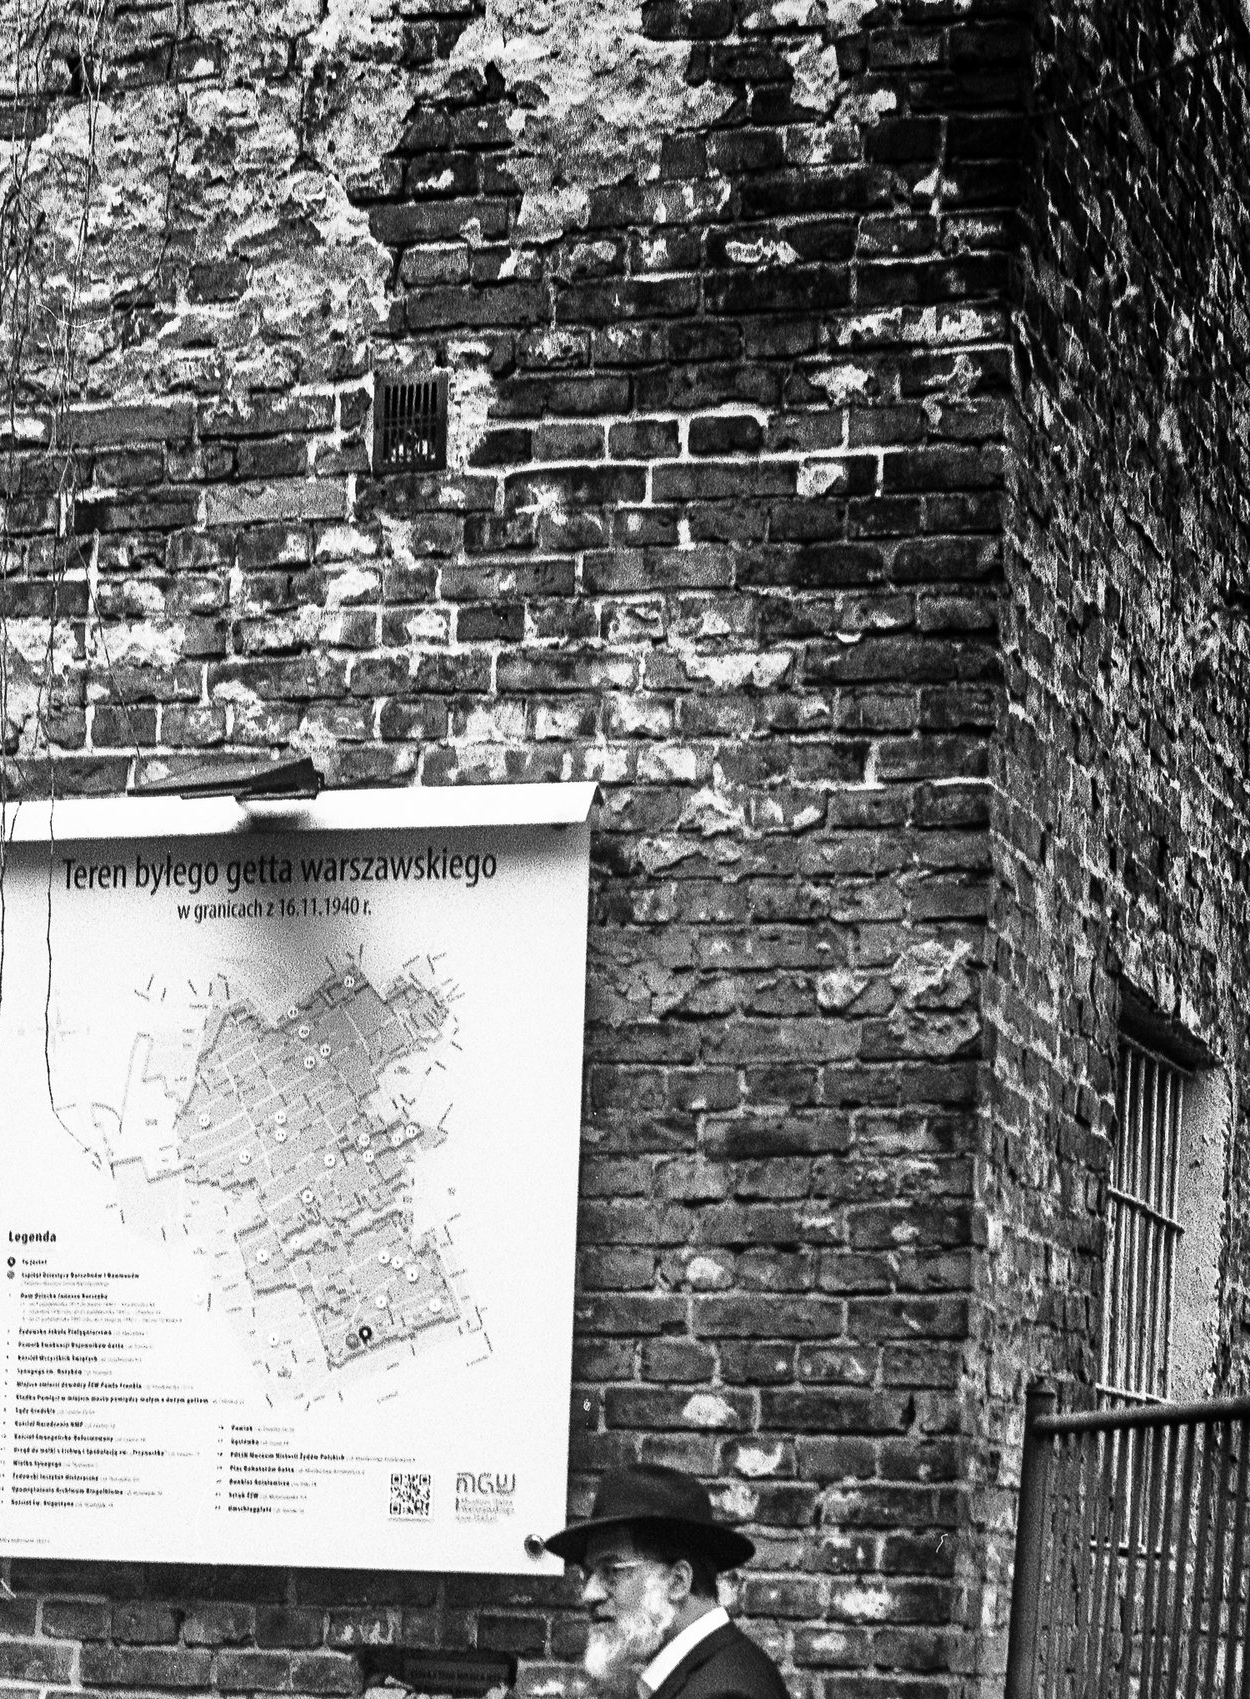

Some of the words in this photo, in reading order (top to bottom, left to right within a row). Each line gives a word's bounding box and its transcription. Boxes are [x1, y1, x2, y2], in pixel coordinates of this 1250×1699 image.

[63, 858, 127, 889] Teren
[136, 855, 219, 895] byłego
[227, 853, 292, 893] getta
[301, 846, 497, 888] warszawskiego
[178, 904, 190, 919] w
[194, 900, 262, 923] granicach
[267, 902, 274, 917] z
[280, 896, 359, 917] 16.11.1940
[363, 900, 372, 915] r.
[9, 1230, 57, 1245] Legenda
